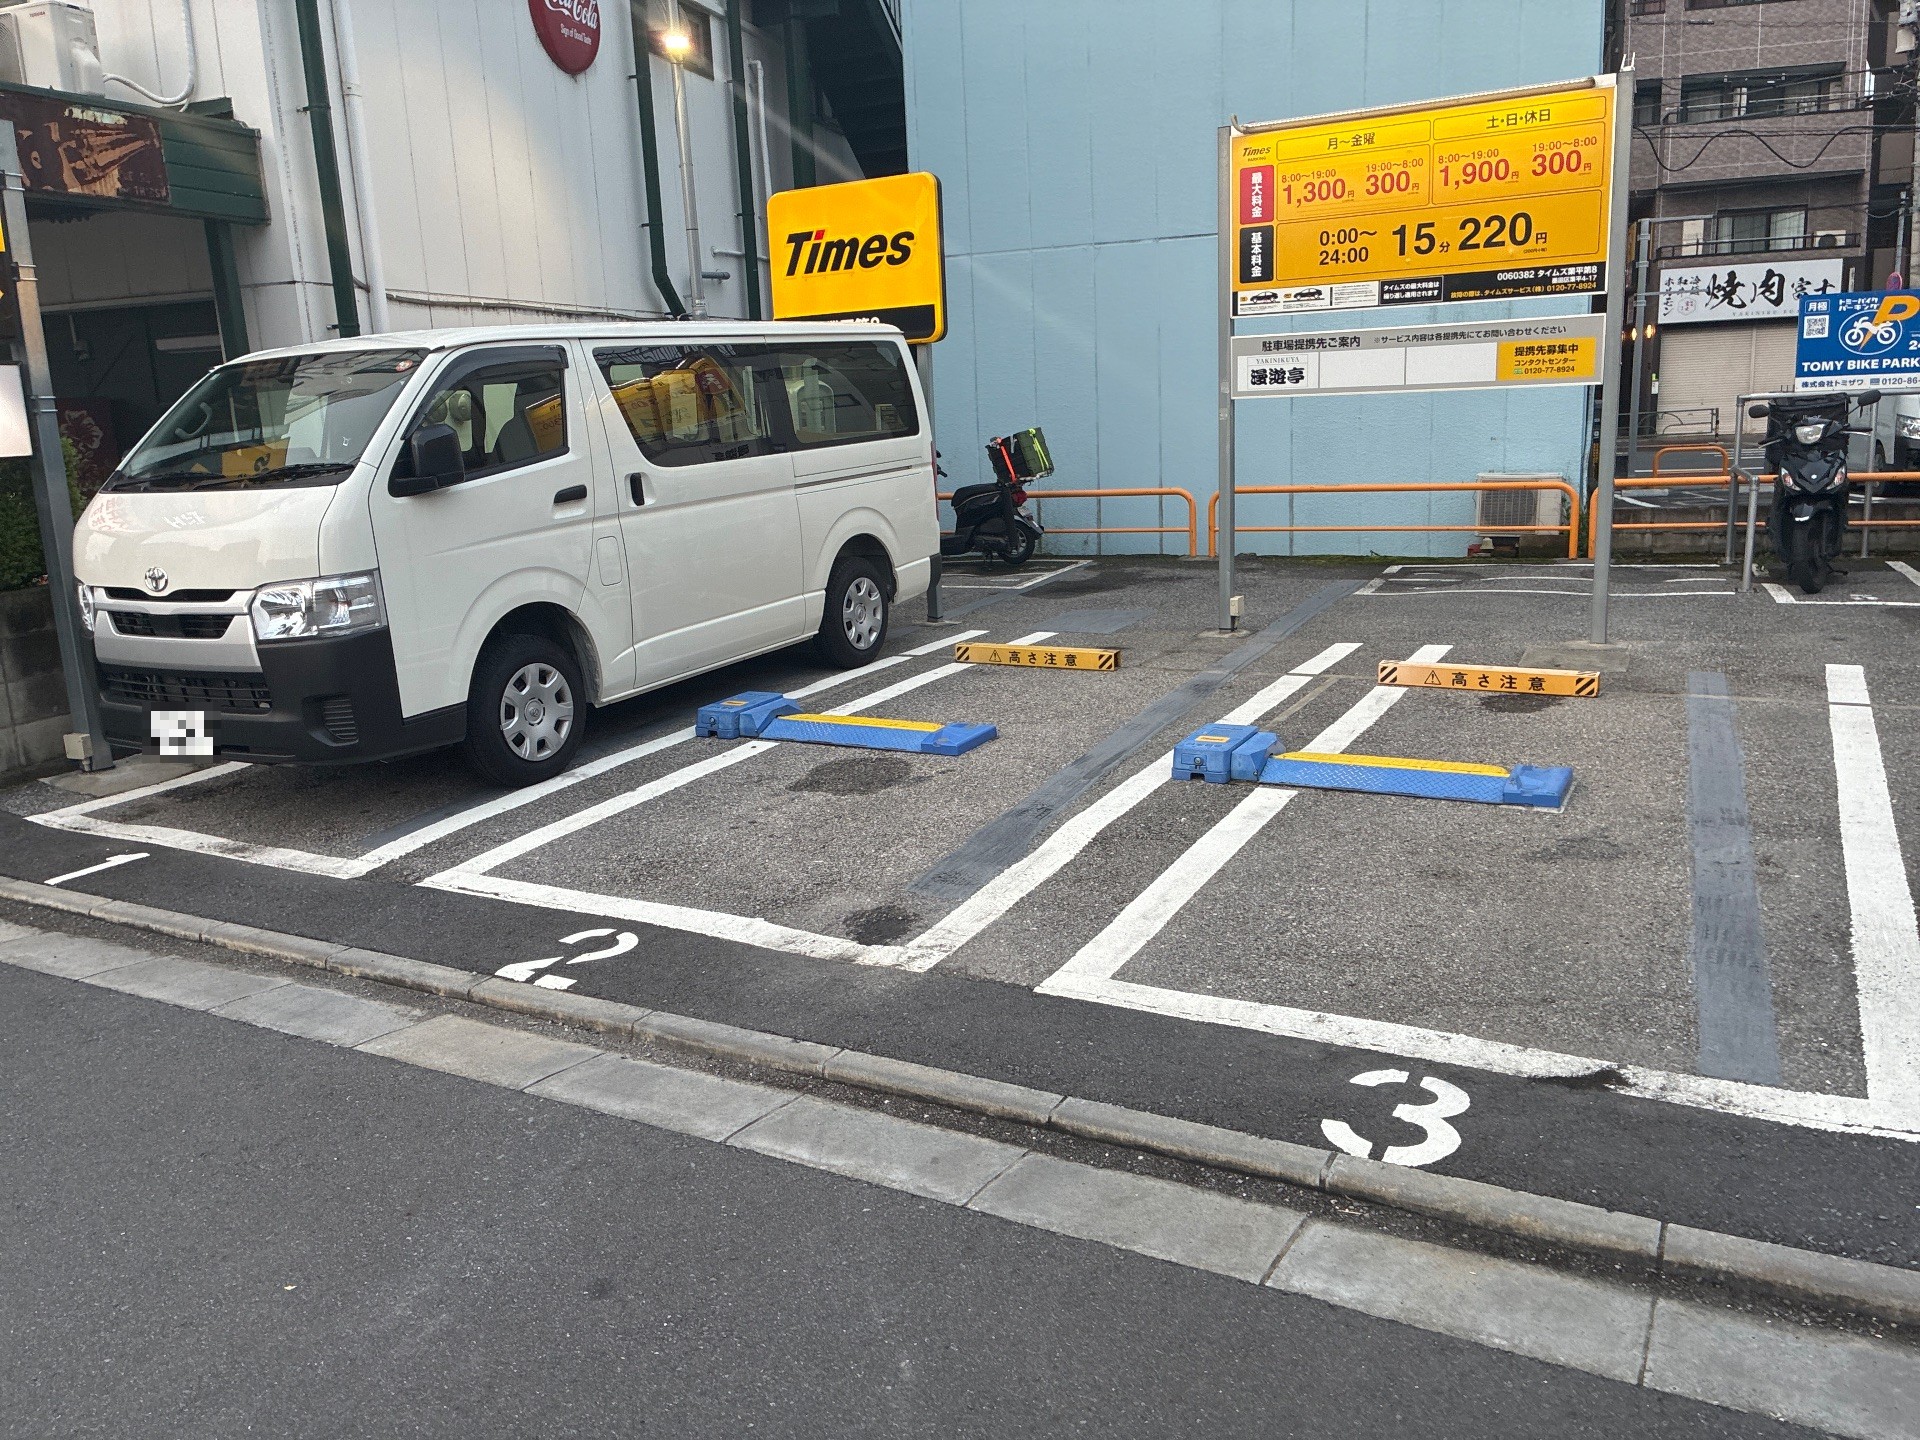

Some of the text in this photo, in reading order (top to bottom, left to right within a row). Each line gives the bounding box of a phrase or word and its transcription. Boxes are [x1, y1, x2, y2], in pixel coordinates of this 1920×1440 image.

[1327, 132, 1376, 150] 月～金曜
[1532, 136, 1597, 153] 19:00～8:00
[1242, 146, 1272, 157] Times
[1438, 148, 1499, 164] 8:00～19:00
[1365, 158, 1424, 173] 19:00～8:00
[1281, 168, 1336, 183] 8:00～19:00
[1251, 172, 1263, 218] 最大料金
[1319, 227, 1378, 247] 0:00～
[785, 229, 915, 277] Times
[1250, 231, 1263, 277] 基本料金
[1319, 246, 1369, 266] 24:00
[1497, 270, 1535, 281] 0060382
[1546, 281, 1597, 292] 0120-77-8924
[1807, 301, 1828, 312] 月極
[1838, 297, 1879, 305] トミーバイク
[1838, 303, 1880, 312] パーキング
[1261, 336, 1361, 352] 駐車場提携先ご案内
[1514, 343, 1579, 357] 提携先募集中
[1255, 356, 1300, 364] YAKINIKUYA
[1514, 357, 1576, 367] コンタクトセンター
[1801, 360, 1844, 372] TOMY
[1847, 358, 1880, 370] BIKE
[1524, 366, 1575, 375] 0120-77-8924
[1801, 378, 1864, 388] 株式会社トミザワ
[1008, 650, 1078, 667] 高さ注意
[1451, 671, 1547, 692] 高さ注意
[43, 852, 150, 886] 1
[494, 928, 639, 990] 2
[1320, 1068, 1471, 1167] 3
